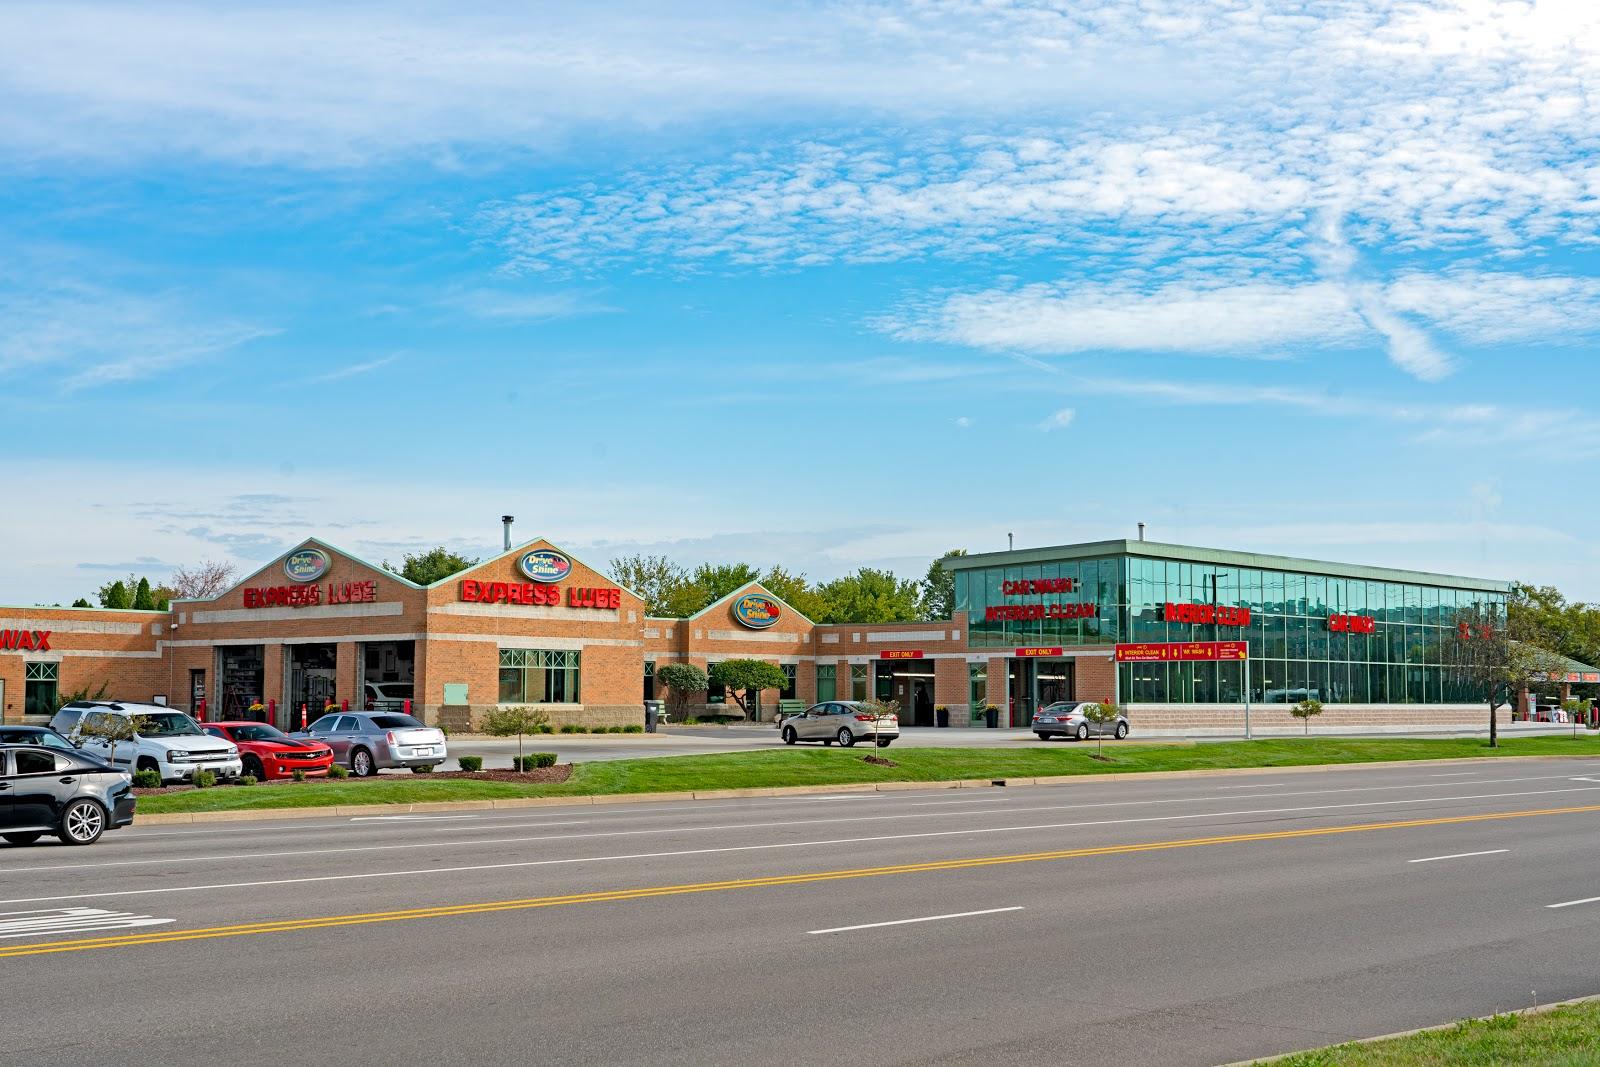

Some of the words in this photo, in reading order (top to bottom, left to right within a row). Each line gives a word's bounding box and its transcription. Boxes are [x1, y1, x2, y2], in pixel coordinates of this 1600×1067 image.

[243, 583, 321, 608] EXPRESS
[328, 580, 376, 604] LUBE
[461, 579, 561, 606] EXPRESS
[568, 587, 621, 609] LUBE
[1002, 579, 1030, 596] CAR
[1033, 578, 1073, 595] WASH
[985, 604, 1046, 621] INTERIOR
[1048, 602, 1096, 619] CLEAN
[1025, 648, 1037, 656] EXIT
